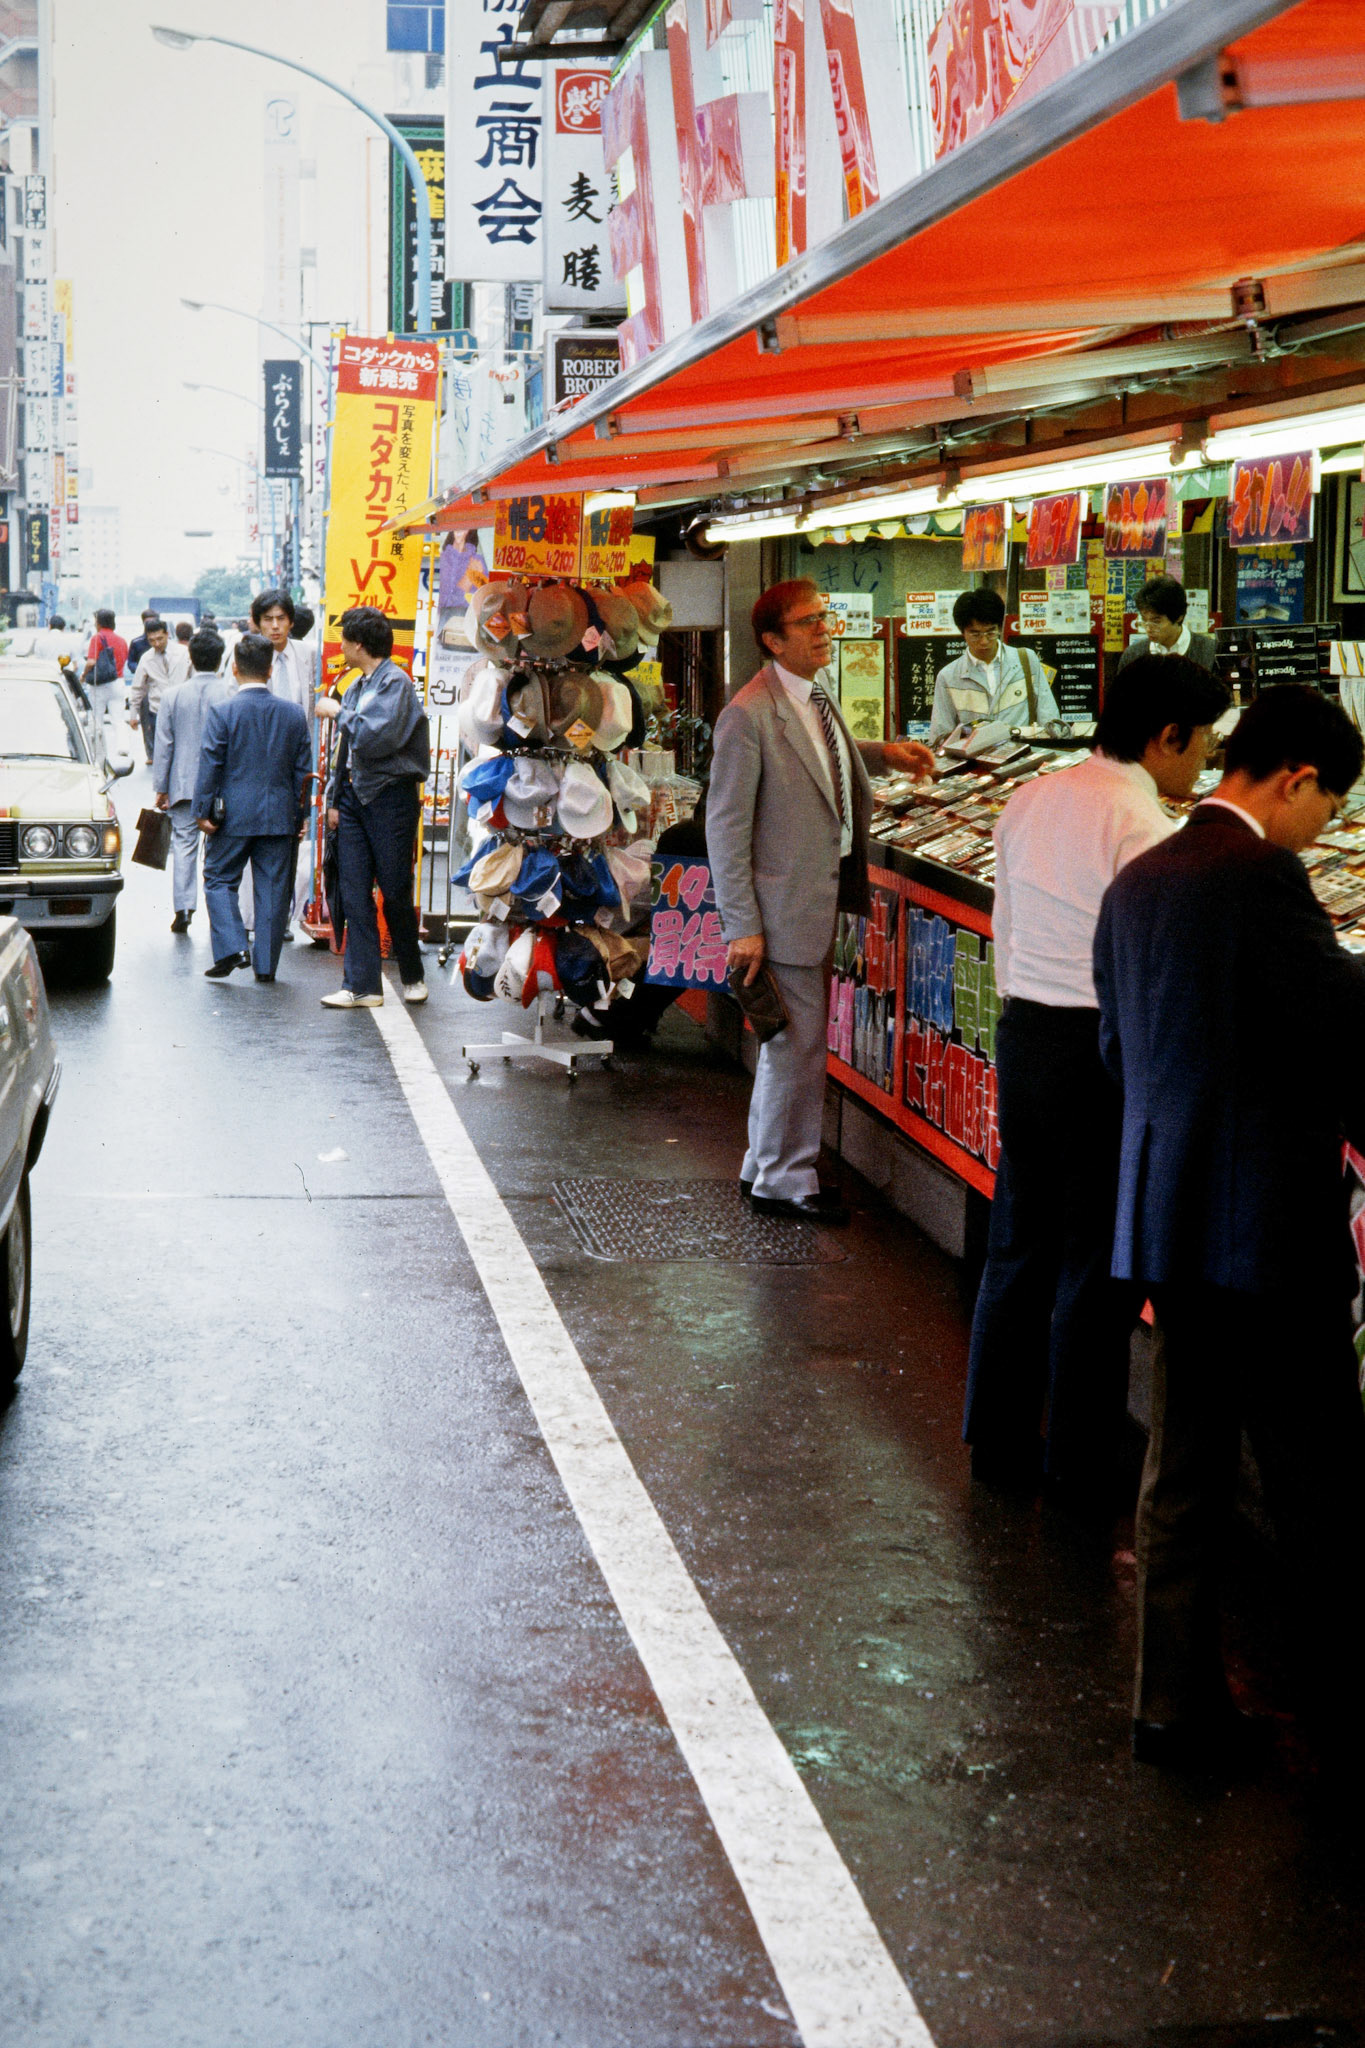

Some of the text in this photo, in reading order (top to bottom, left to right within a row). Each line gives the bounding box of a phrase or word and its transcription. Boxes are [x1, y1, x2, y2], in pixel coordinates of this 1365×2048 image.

[343, 344, 436, 372] コダックから
[359, 366, 419, 392] 新発売
[365, 402, 401, 558] コダカラー
[390, 404, 416, 563] 写真を変えた、4つ度。
[350, 557, 397, 594] VR
[347, 593, 399, 615] フィルム
[908, 594, 935, 602] Canon
[1022, 593, 1048, 601] Canon
[647, 909, 729, 984] 買得
